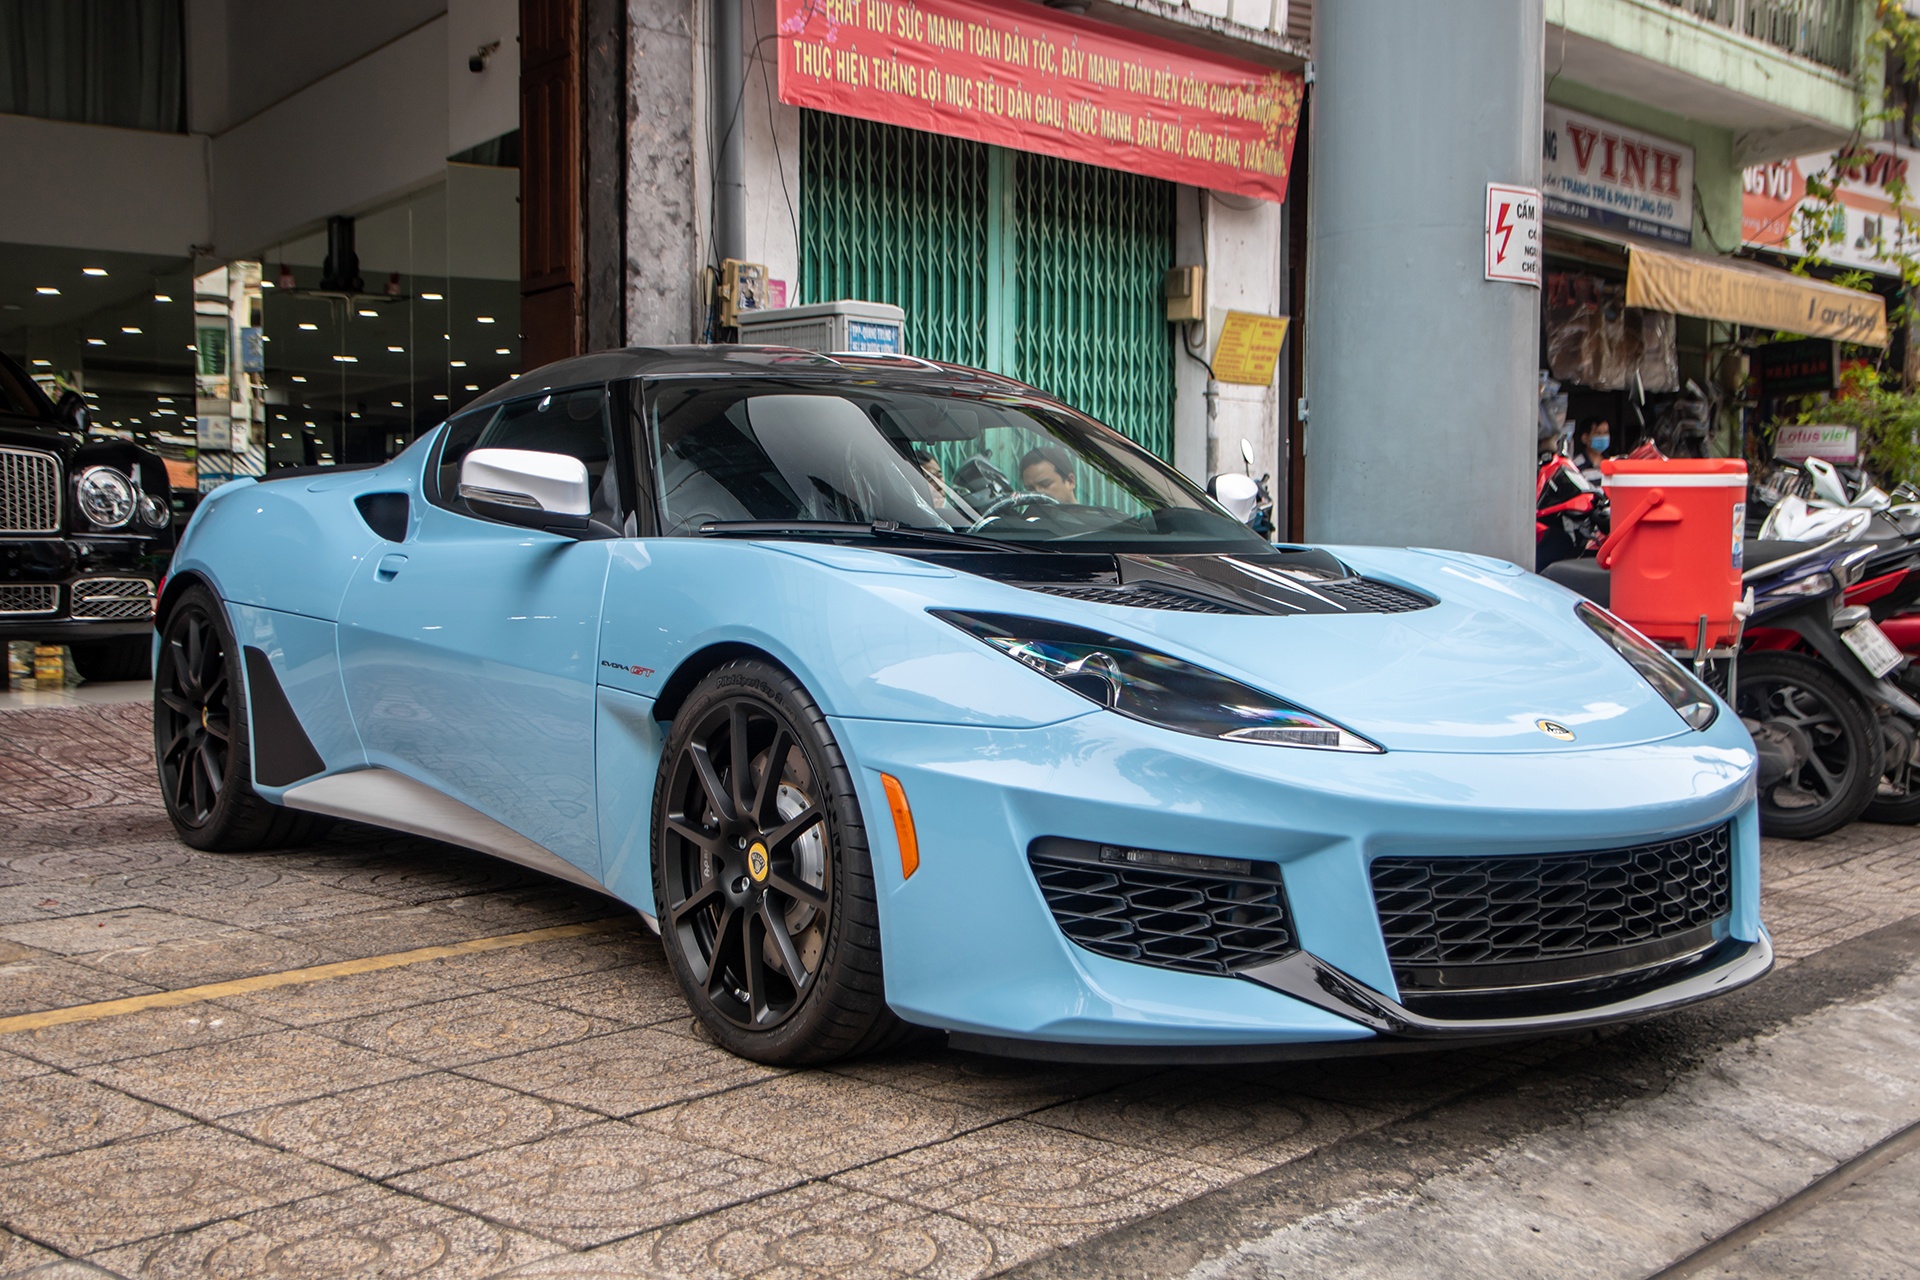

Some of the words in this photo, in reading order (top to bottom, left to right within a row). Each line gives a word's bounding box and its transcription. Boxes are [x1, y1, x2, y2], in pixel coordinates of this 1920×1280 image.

[866, 1, 893, 35] HUY
[897, 0, 923, 42] SỨC
[927, 12, 964, 54] MẠNH
[967, 18, 1001, 60] TOÀN
[1004, 25, 1029, 67] DÂN
[1032, 32, 1058, 80] TỘC,
[1061, 33, 1085, 80] ĐẨY
[1088, 52, 1120, 91] MẠNH
[1123, 58, 1151, 96] TOÀN
[1153, 65, 1179, 106] DIỆN
[1180, 71, 1207, 111] CÔNG
[1209, 80, 1235, 120] CUỘC
[793, 39, 832, 84] THỰC
[836, 43, 869, 92] HIỆN
[872, 47, 917, 97] THẮNG
[920, 66, 941, 108] LỢI
[945, 73, 973, 114] MỤC
[975, 74, 1004, 116] TIÊU
[1008, 80, 1032, 122] DÂN
[1035, 88, 1065, 134] GIÀU,
[1067, 96, 1098, 136] NƯỚC
[1101, 108, 1135, 150] MẠNH,
[1137, 111, 1160, 150] DÂN
[1161, 114, 1185, 160] CHỦ,
[1187, 122, 1213, 162] CÔNG
[1214, 124, 1241, 174] BẰNG,
[1244, 139, 1262, 172] VĂN
[1566, 120, 1682, 200] VINH
[1561, 175, 1591, 199] TRANG
[1516, 199, 1535, 220] CẤM
[601, 660, 629, 672] EVORA
[630, 665, 655, 678] GT
[716, 674, 736, 689] Pilot
[736, 674, 760, 689] Sport
[760, 682, 775, 698] Cup
